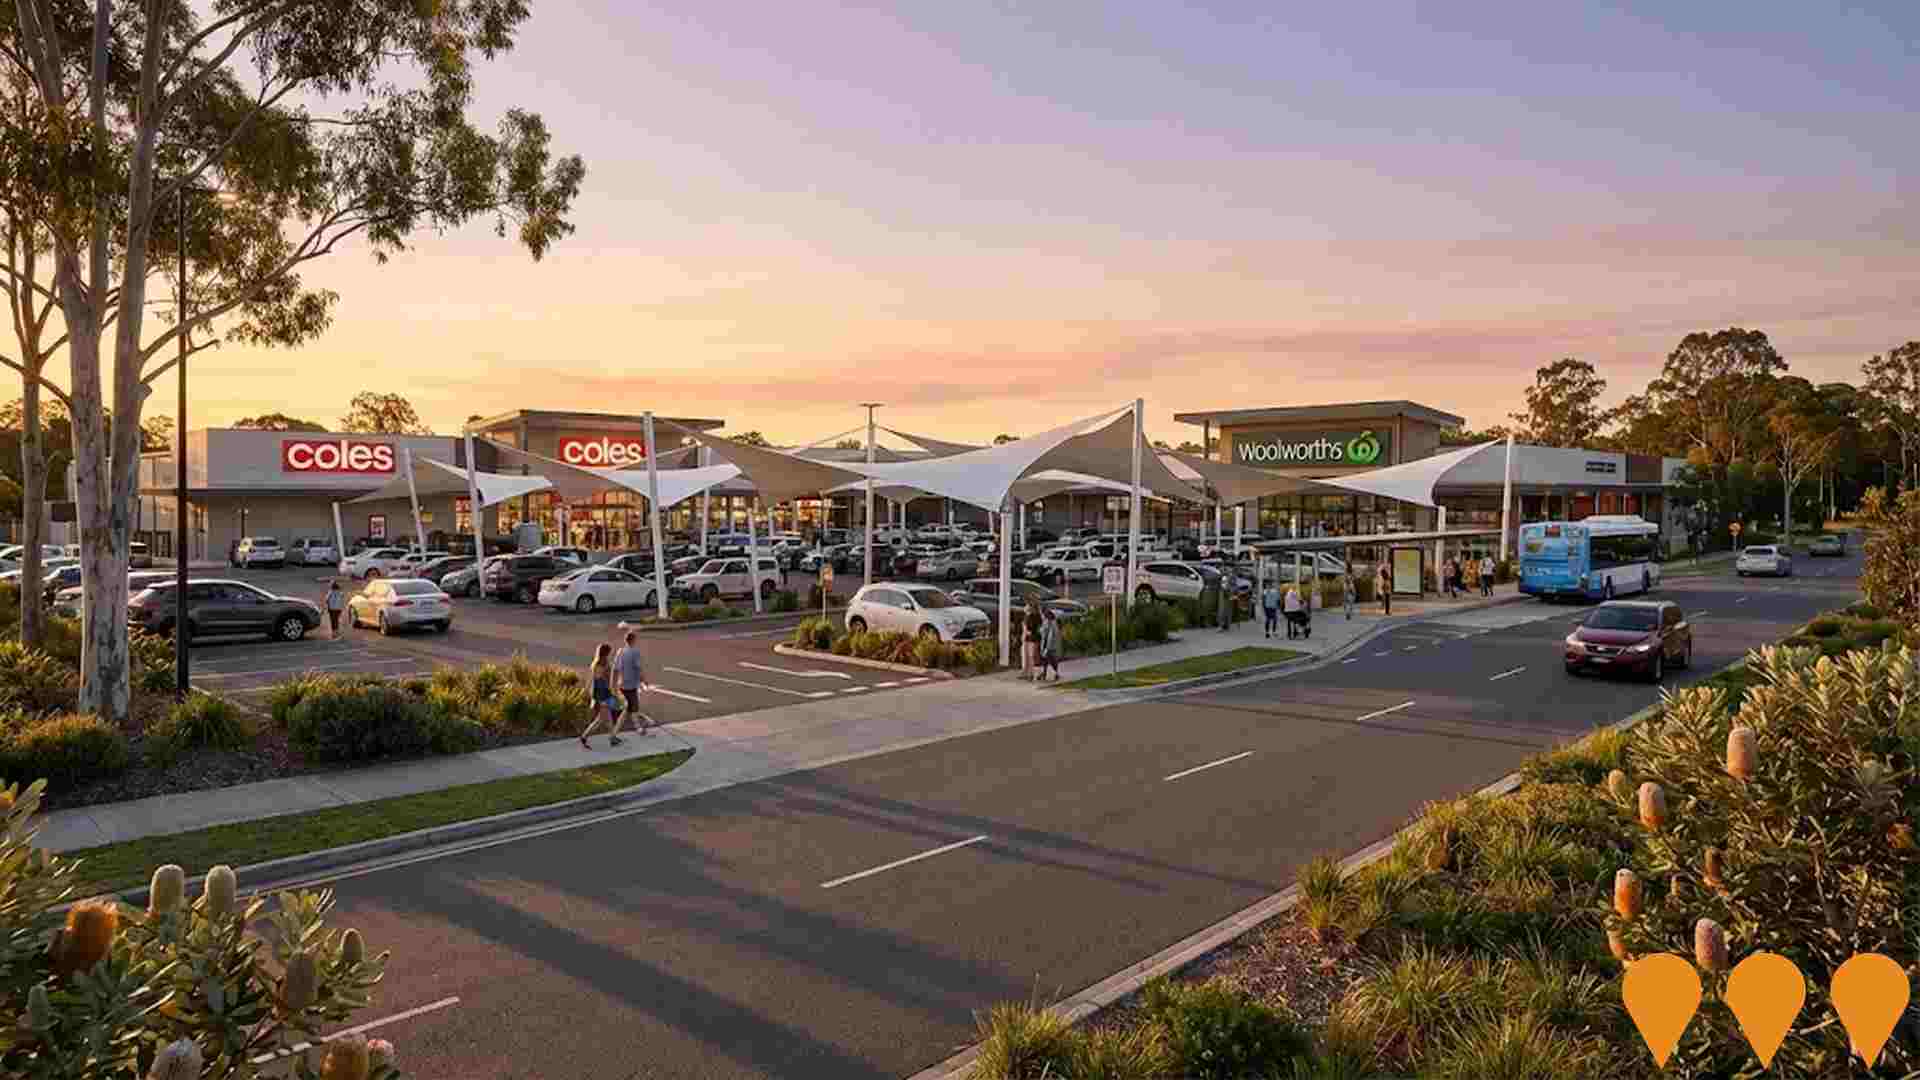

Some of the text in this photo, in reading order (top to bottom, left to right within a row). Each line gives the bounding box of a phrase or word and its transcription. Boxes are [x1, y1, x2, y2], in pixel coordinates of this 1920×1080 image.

[287, 440, 393, 471] coles
[563, 436, 642, 464] coles
[1238, 438, 1344, 460] Woolworths
